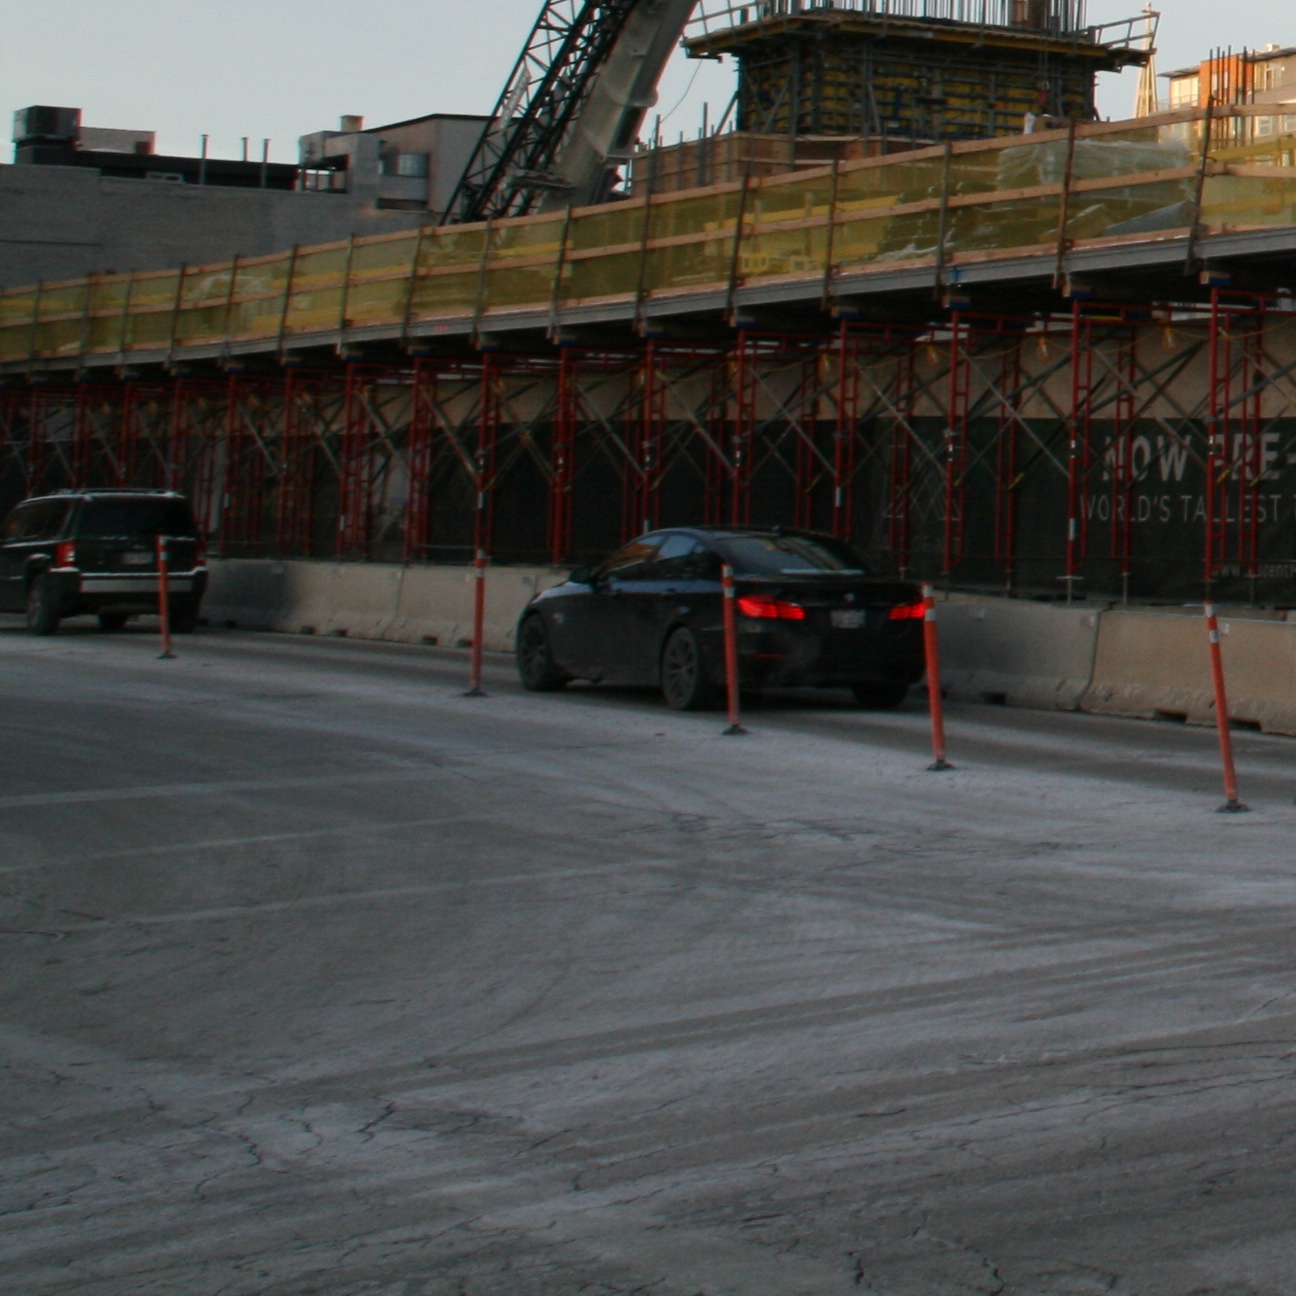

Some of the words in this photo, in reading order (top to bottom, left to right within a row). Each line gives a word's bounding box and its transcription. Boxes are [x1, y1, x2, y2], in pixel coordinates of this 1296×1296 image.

[1103, 434, 1192, 481] NOW
[1079, 495, 1172, 523] WORD'S
[1180, 495, 1282, 523] TALEST
